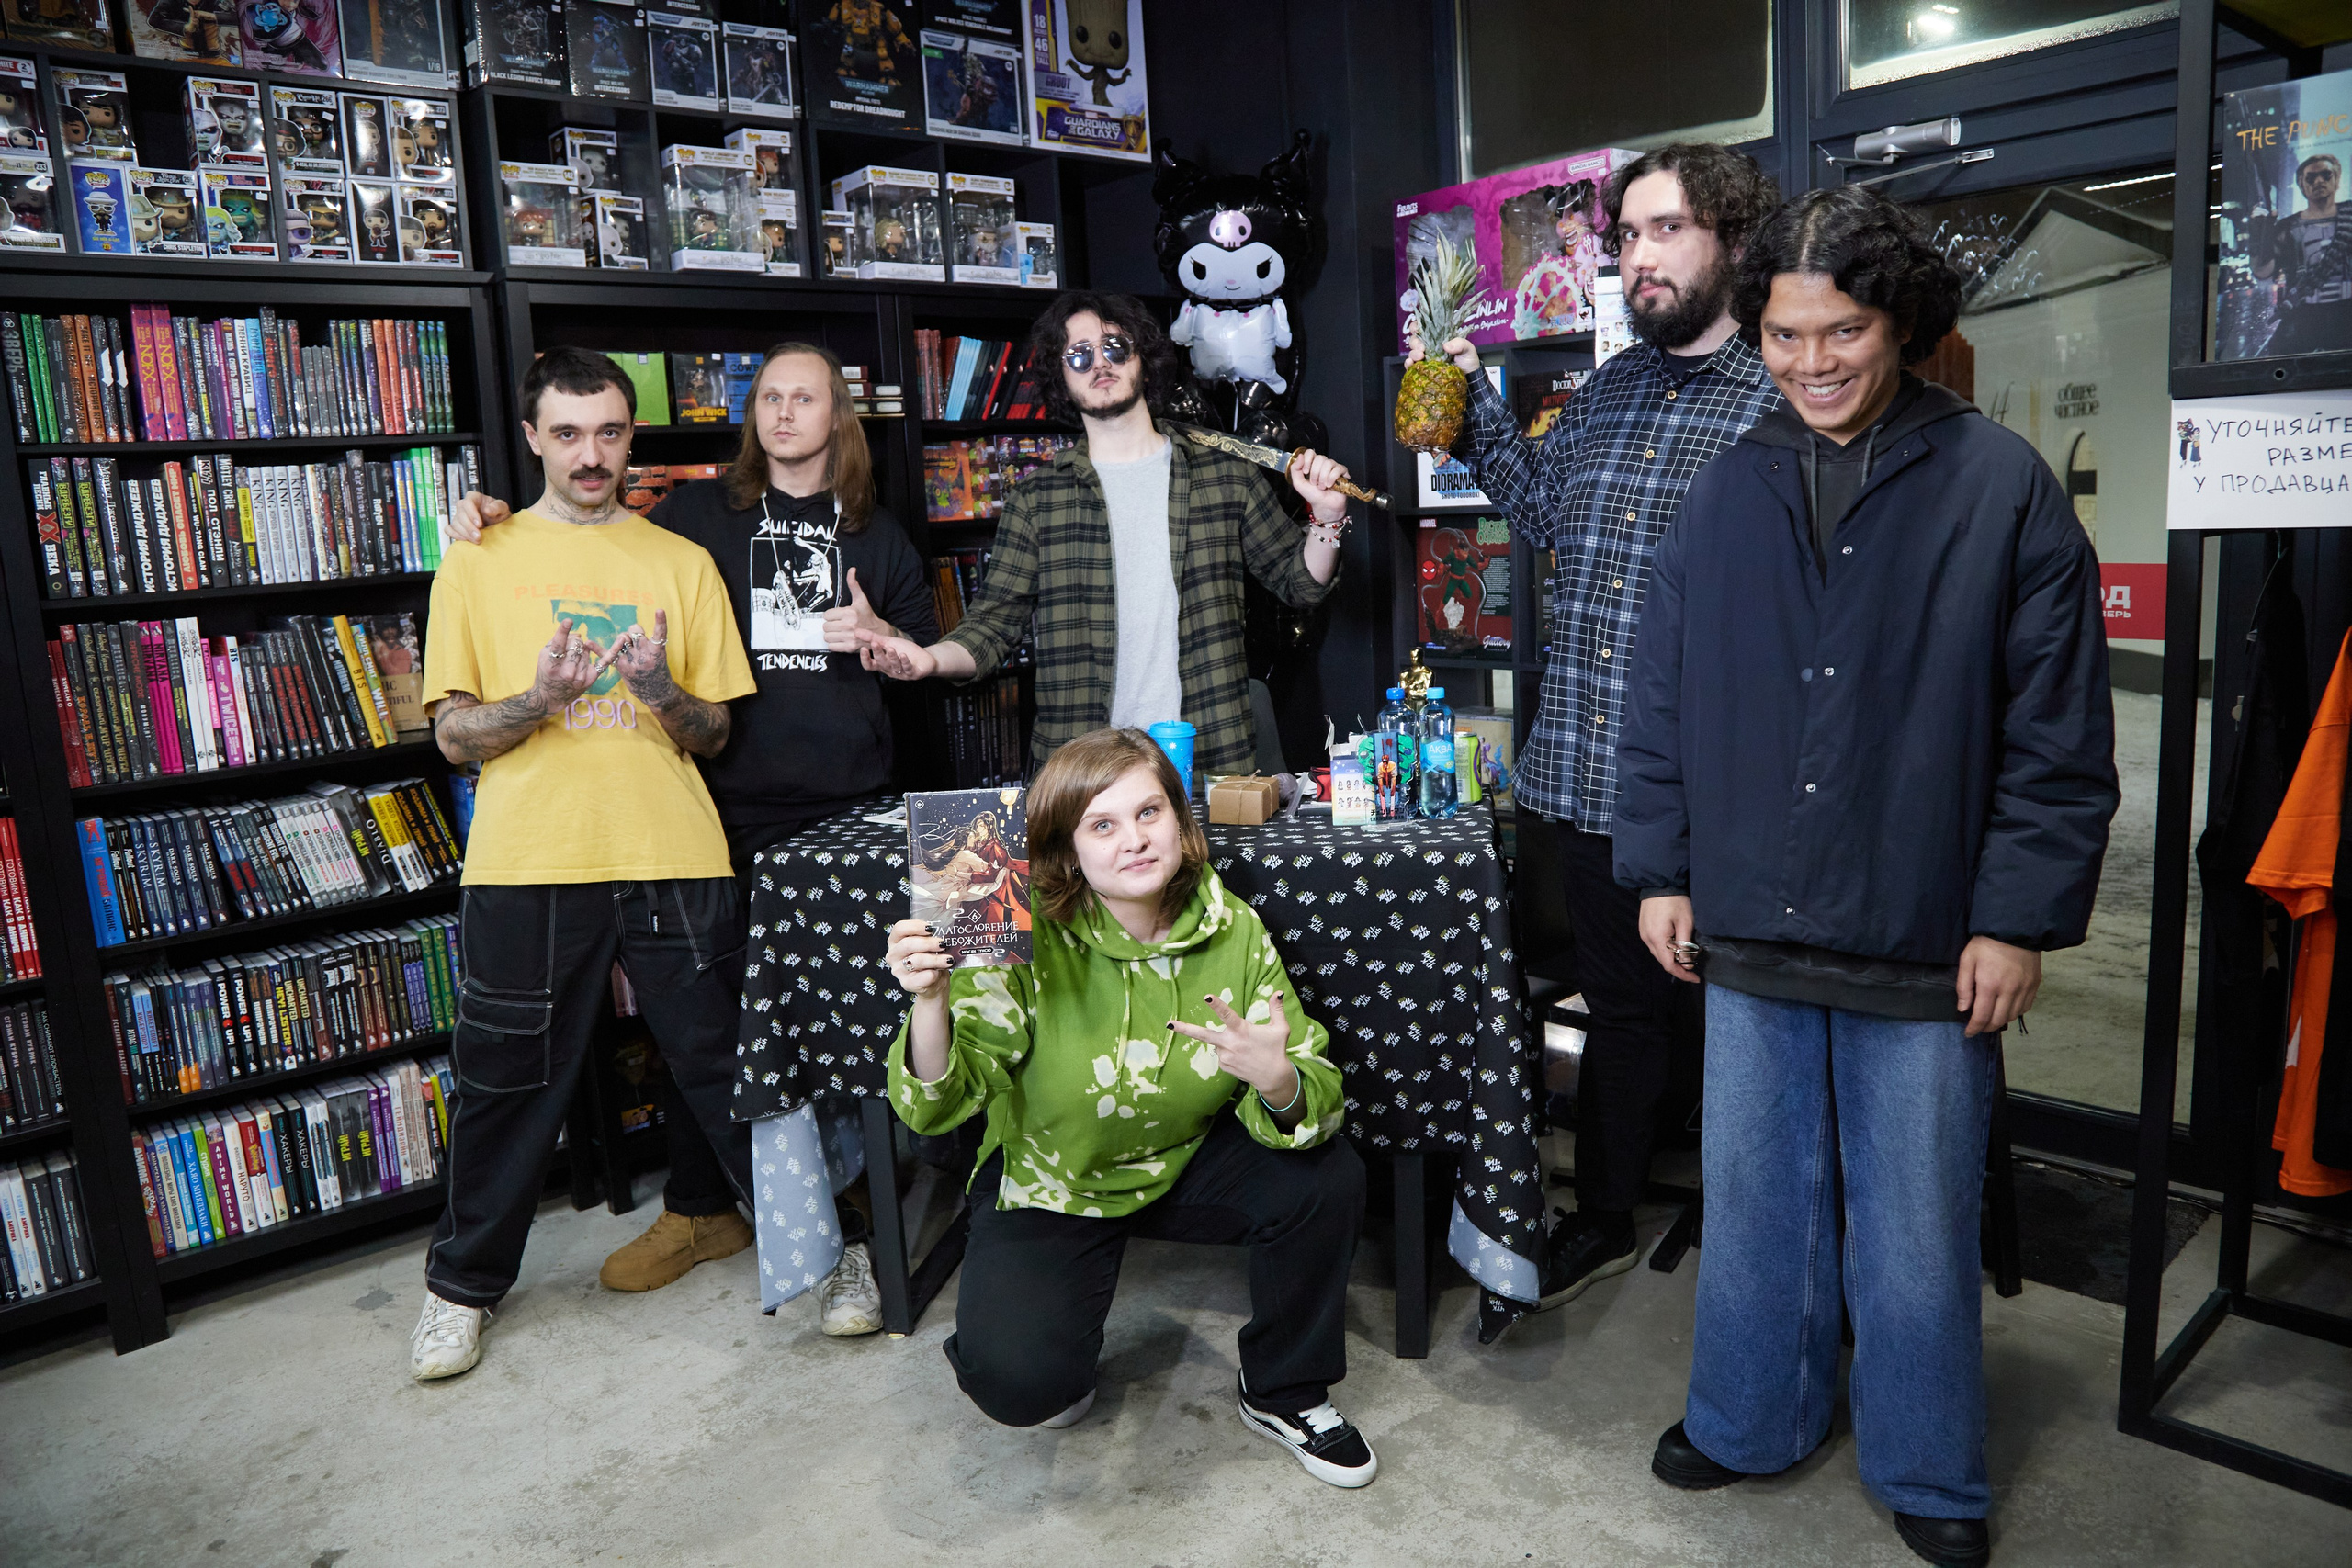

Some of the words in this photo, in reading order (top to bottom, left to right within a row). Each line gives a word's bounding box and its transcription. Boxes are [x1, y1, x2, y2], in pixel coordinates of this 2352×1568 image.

[1034, 14, 1046, 28] 18
[1035, 38, 1048, 51] 46
[845, 80, 889, 93] WARHAMMER
[1046, 75, 1071, 89] GROOT
[830, 100, 865, 112] REDEMPTOR
[865, 106, 906, 118] DREADNOUGHT
[1064, 116, 1121, 131] GUARDIANS
[1077, 127, 1121, 141] GALAXY
[2236, 126, 2278, 152] THE
[35, 162, 47, 172] 233
[1570, 163, 1588, 172] BANDAI
[1587, 159, 1604, 168] NAMCO
[2, 330, 26, 373] ЗВЕРЬ
[193, 339, 202, 359] RUST
[238, 324, 246, 355] ЛЕННИ
[139, 344, 157, 382] NOFX
[159, 344, 178, 382] NOFX
[196, 359, 202, 370] IN
[241, 357, 253, 394] КРАВИЦ
[198, 370, 207, 394] PEACE
[1552, 379, 1571, 392] DOCTOR
[2058, 382, 2098, 403] общее
[680, 408, 706, 418] JOHN
[706, 407, 728, 417] WICK
[2054, 400, 2100, 420] частное
[198, 459, 213, 485] KISS
[218, 458, 232, 487] MÖTLEY
[466, 450, 477, 469] ЮРИЙ
[39, 470, 52, 510] ГЛАВНЫЕ
[169, 468, 178, 491] МИР
[469, 470, 479, 484] ХОЙ
[2193, 475, 2206, 494] У
[2221, 471, 2350, 494] ПРОДАВЦА
[33, 483, 44, 511] ПЕСНИ
[58, 483, 74, 527] ВДРЕБЕЗГИ
[100, 465, 112, 498] Майкл
[107, 501, 119, 544] Джексон
[207, 489, 219, 513] ПОЛ
[223, 489, 235, 510] CRÜE
[251, 479, 264, 509] KING
[264, 479, 276, 508] KING
[290, 478, 302, 506] KING
[128, 479, 149, 538] ДИДЖЕЕВ
[150, 479, 170, 537] ДИДЖЕЕВ
[36, 511, 62, 544] XX
[1419, 519, 1437, 527] MARVEL
[1476, 529, 1510, 545] OCTOPUS
[1477, 517, 1509, 532] DOCTOR
[179, 529, 191, 573] ЛЮБОВЬ
[192, 514, 204, 549] WU-TANG
[198, 551, 207, 570] CLAN
[211, 516, 224, 562] СТЭНЛИ
[45, 544, 61, 576] ВЕКА
[138, 539, 156, 593] ИСТОРИЯ
[161, 538, 178, 592] ИСТОРИЯ
[514, 583, 656, 607] PLEASURES
[229, 648, 238, 662] BTS
[358, 633, 372, 656] УИЛЛ
[365, 657, 378, 679] СМИТ
[1482, 635, 1512, 649] Gallery
[129, 640, 141, 673] DEPECHE
[135, 675, 144, 699] MODE
[142, 643, 156, 682] NIRVANA
[153, 643, 168, 682] NIRVANA
[757, 653, 828, 673] TENDENCIES
[220, 694, 239, 737] TWICE
[371, 687, 389, 719] WILL
[565, 697, 638, 731] 1990
[1428, 744, 1453, 754] АКВА
[395, 792, 415, 822] КОДЗИМА
[185, 844, 193, 862] DARK
[259, 825, 277, 850] RESIDENT
[268, 849, 280, 862] EVIL
[289, 840, 305, 869] NINTENDO
[351, 829, 370, 857] ИГРАЙ!
[366, 818, 392, 865] DIABLO
[110, 850, 122, 870] Fallout
[135, 843, 152, 888] SKYRIM
[149, 841, 166, 887] SKYRIM
[168, 847, 176, 864] DARK
[172, 865, 182, 886] SOULS
[188, 863, 198, 882] SOULS
[6, 858, 18, 895] ГОТОВИМ,
[302, 869, 312, 886] ИСТОРИЯ
[12, 897, 24, 914] КАК
[94, 856, 112, 897] ИГРОВОЙ
[103, 898, 117, 932] БАЛАНС
[17, 923, 31, 951] АНИМЕ
[234, 978, 248, 1015] POWER
[243, 1024, 252, 1042] UP!
[276, 986, 285, 1008] HEY!
[284, 980, 298, 1021] UNCHARTED
[297, 977, 311, 1019] UNCHARTED
[218, 982, 231, 1019] POWER
[225, 1028, 235, 1045] UP!
[279, 1010, 293, 1046] LISTEN!
[137, 1011, 149, 1050] КИБЕРСПОРТ
[147, 1010, 159, 1049] КИБЕРСПОРТ
[27, 1039, 37, 1064] КУБРИК
[43, 1023, 54, 1054] СНИМАЮТ
[50, 1055, 62, 1096] БЛОКБАСТЕРЫ
[394, 1106, 407, 1156] ГЕЙМДИЗАЙН
[234, 1146, 243, 1170] ФИЛОСОФИЯ
[279, 1134, 294, 1174] ХАКЕРЫ
[296, 1129, 310, 1168] ХАКЕРЫ
[337, 1134, 352, 1162] ИГРАЙ!
[133, 1147, 149, 1186] АНИМЕ
[187, 1161, 198, 1184] ХАЯО
[200, 1152, 210, 1177] СТУДИЯ
[205, 1177, 215, 1198] Ghibli
[215, 1145, 226, 1180] ANIME
[221, 1183, 234, 1219] WORLD
[238, 1171, 251, 1201] НАРУТО
[192, 1184, 209, 1228] МИЯДЗАКИ
[21, 1217, 30, 1239] АМЕРИКА
